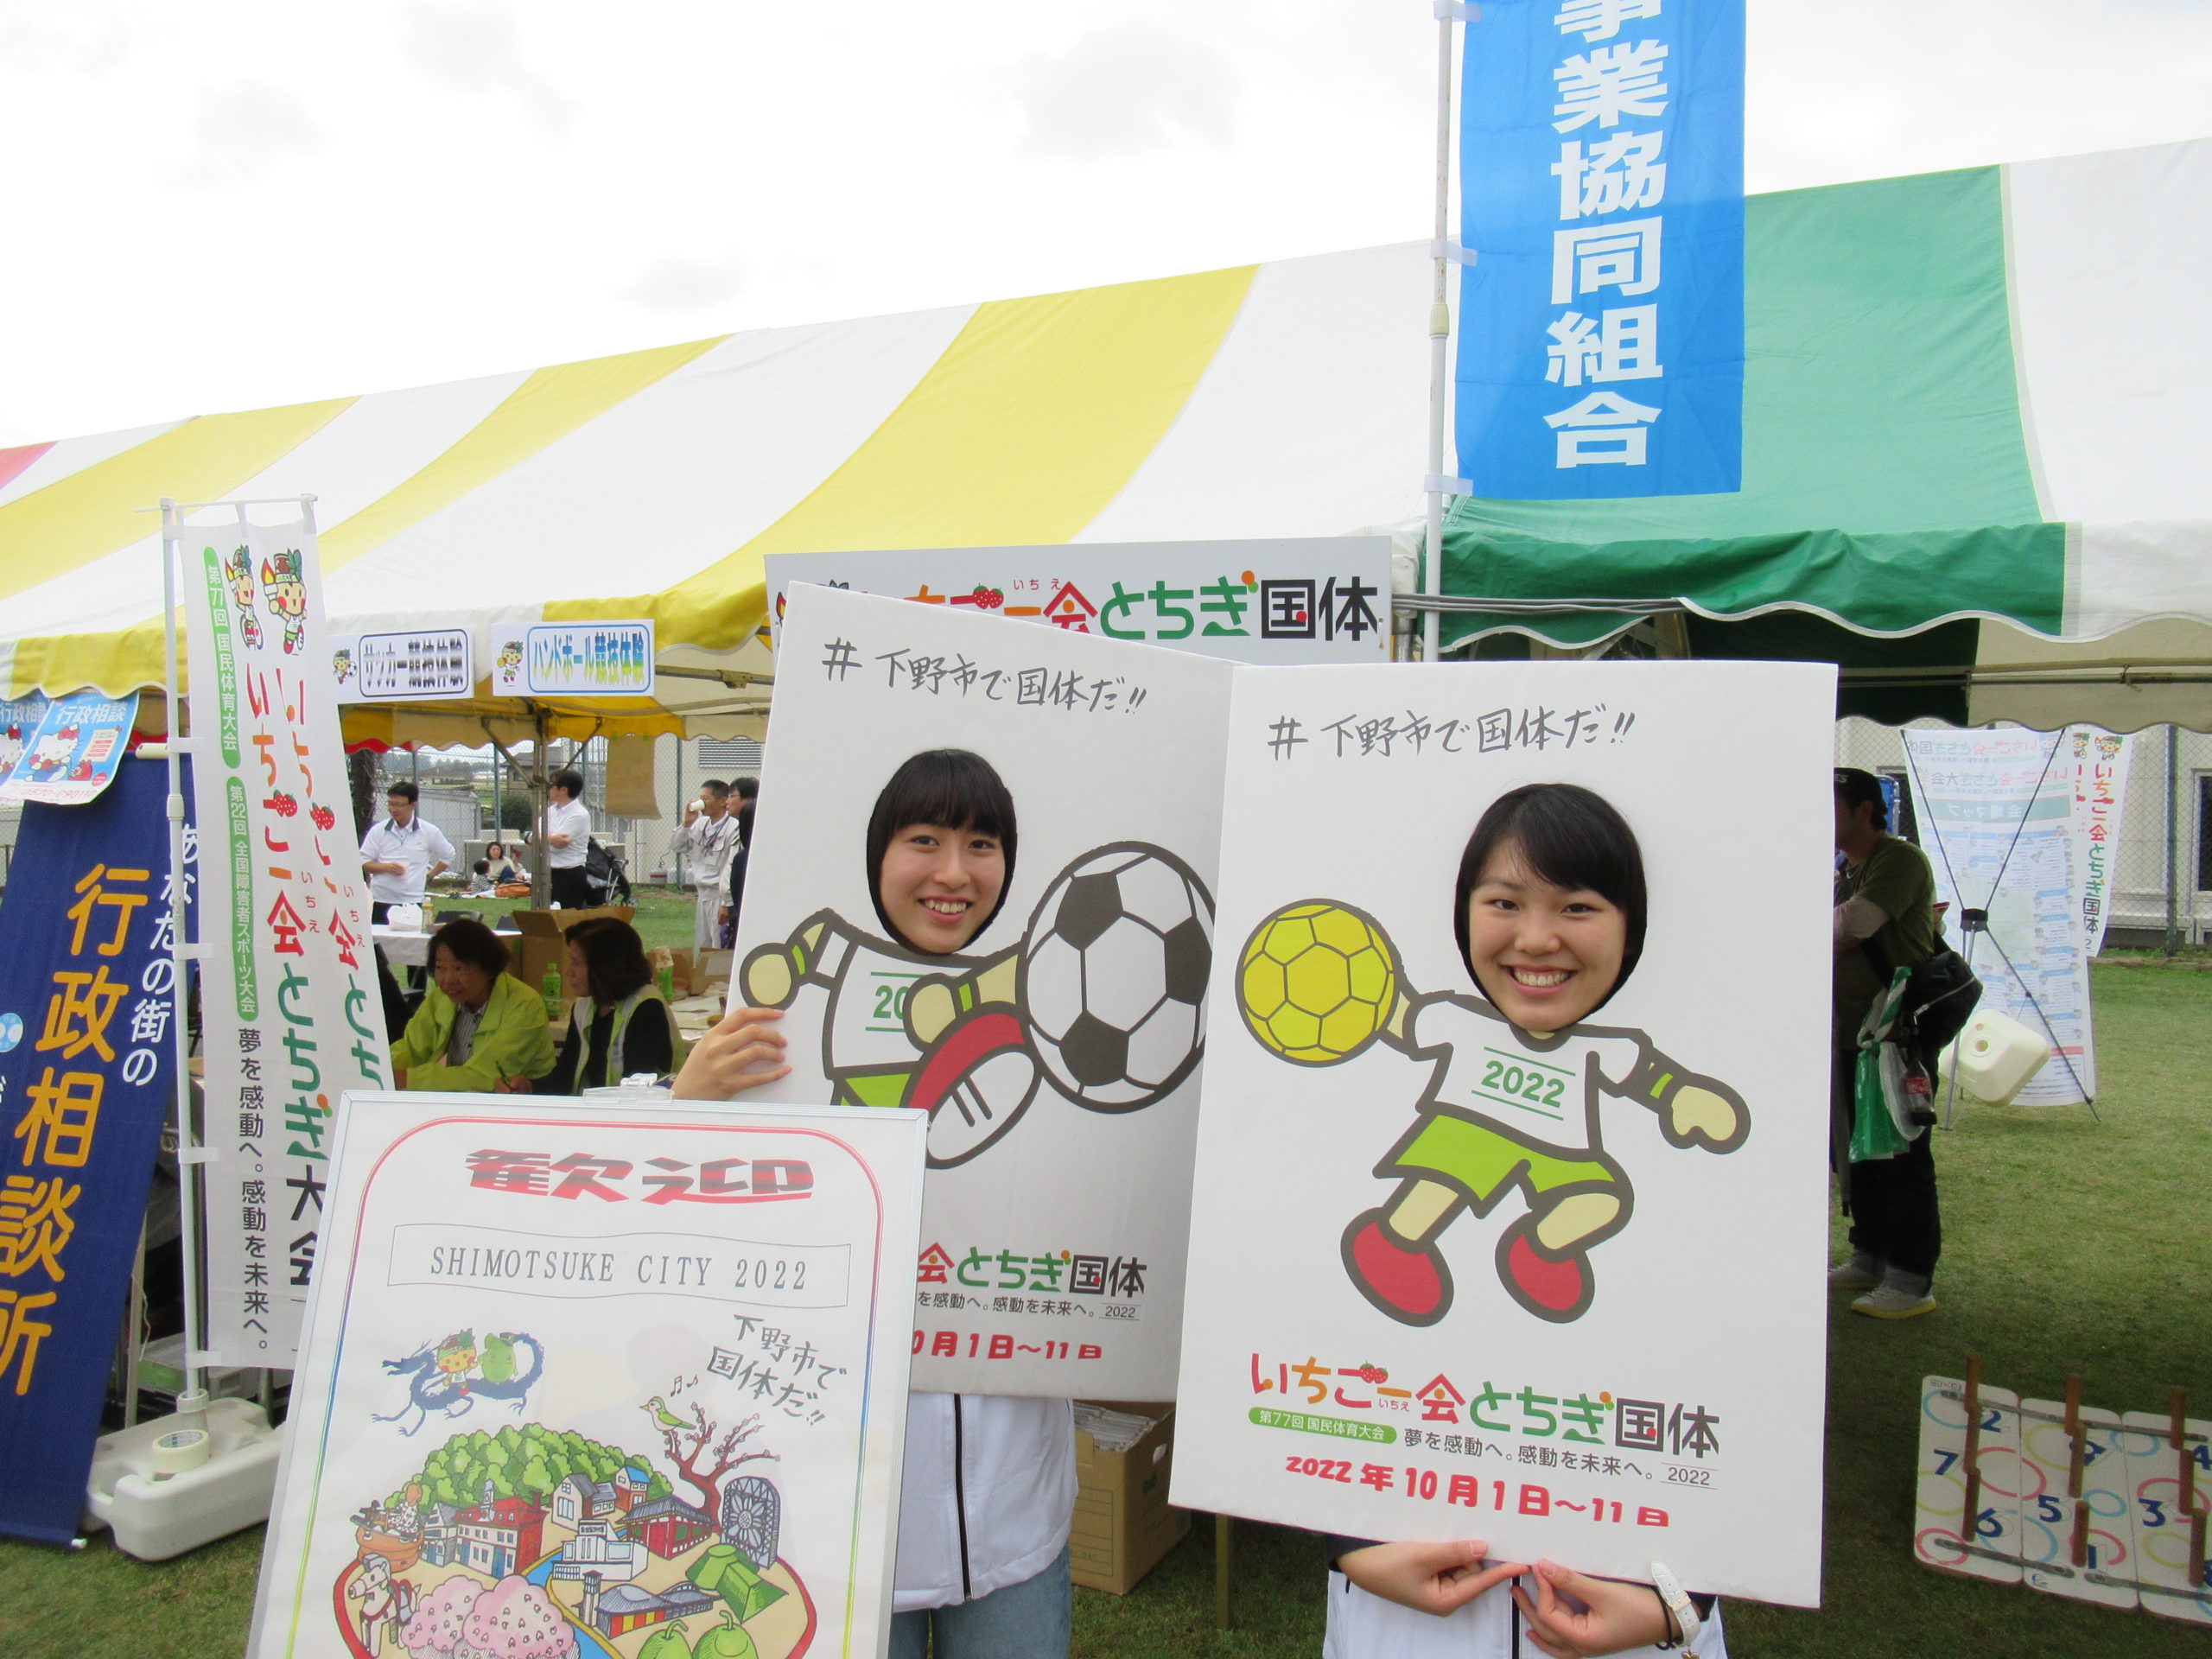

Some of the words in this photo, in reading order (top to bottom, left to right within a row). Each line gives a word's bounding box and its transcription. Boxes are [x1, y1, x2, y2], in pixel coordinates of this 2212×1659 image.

[55, 702, 128, 725] 行政相談
[1480, 1059, 1565, 1109] 2022
[429, 1245, 614, 1284] SHIMOTSUKE
[637, 1252, 713, 1287] CITY
[734, 1257, 809, 1291] 2022
[1104, 1306, 1136, 1319] 2022
[734, 1313, 848, 1390] 下野市で
[1668, 1465, 1711, 1486] 2022
[1933, 1448, 1960, 1476] 7
[1974, 1508, 2004, 1538] 6
[2037, 1494, 2063, 1523] 5
[2138, 1497, 2167, 1528] 3
